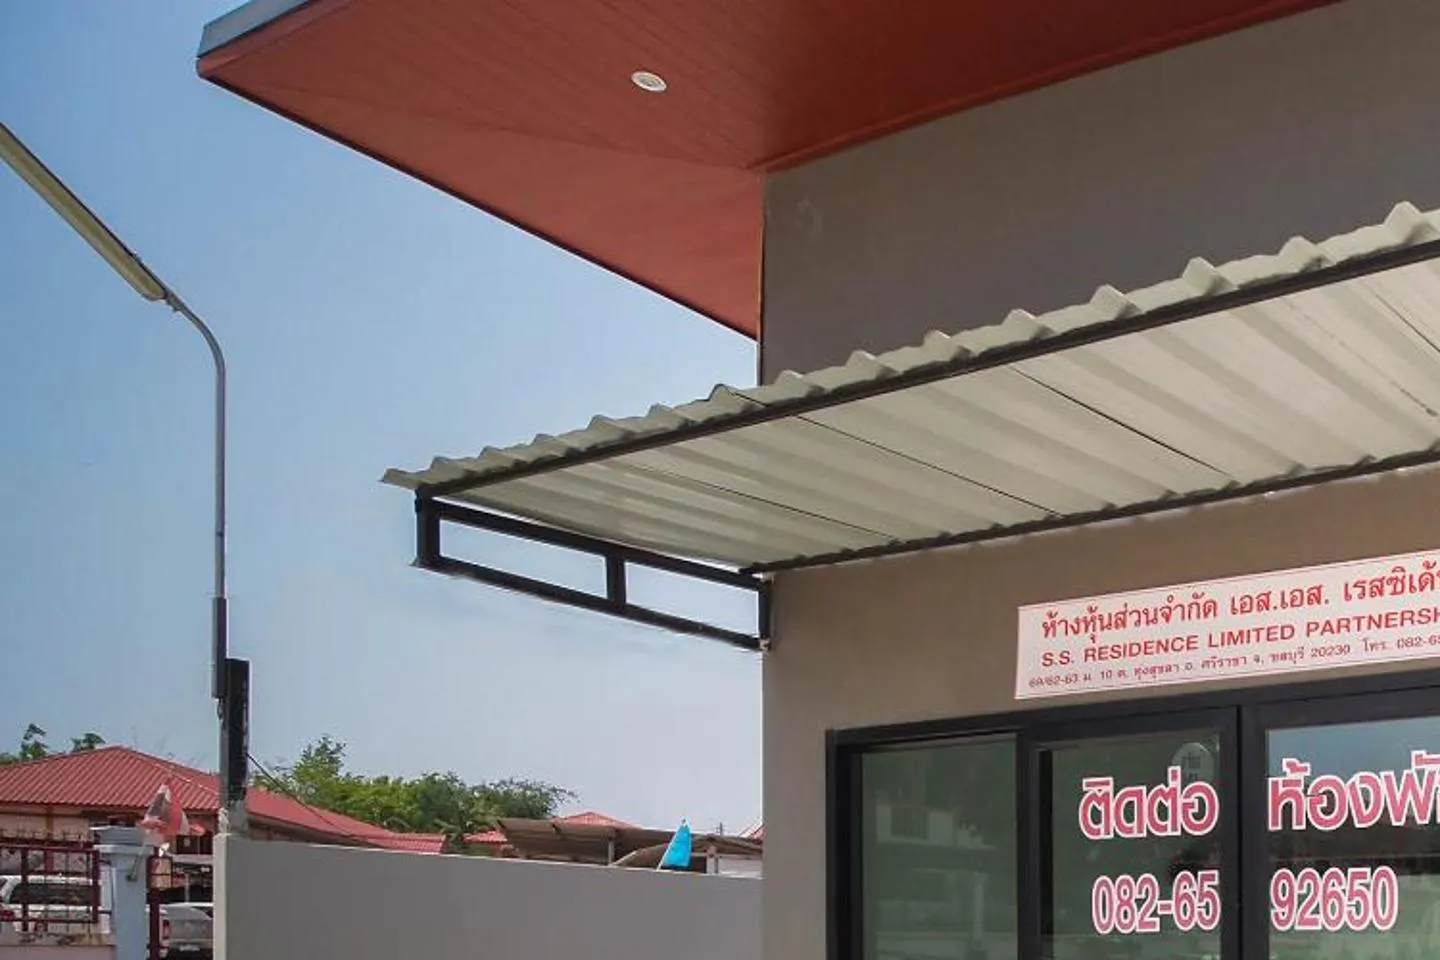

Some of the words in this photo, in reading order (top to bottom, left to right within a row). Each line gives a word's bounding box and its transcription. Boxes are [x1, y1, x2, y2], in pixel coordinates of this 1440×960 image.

[1041, 592, 1218, 643] ห้างหุ้นส่วนจำกัด
[1230, 583, 1329, 616] เอส.เอส.
[1042, 650, 1075, 667] S.S.
[1084, 634, 1199, 662] RESIDENCE
[1207, 624, 1295, 649] LIMITED
[1310, 643, 1351, 659] 20230
[1079, 766, 1220, 840] ติดต่อ
[1092, 869, 1221, 934] 082-65
[1270, 866, 1399, 932] 92650
